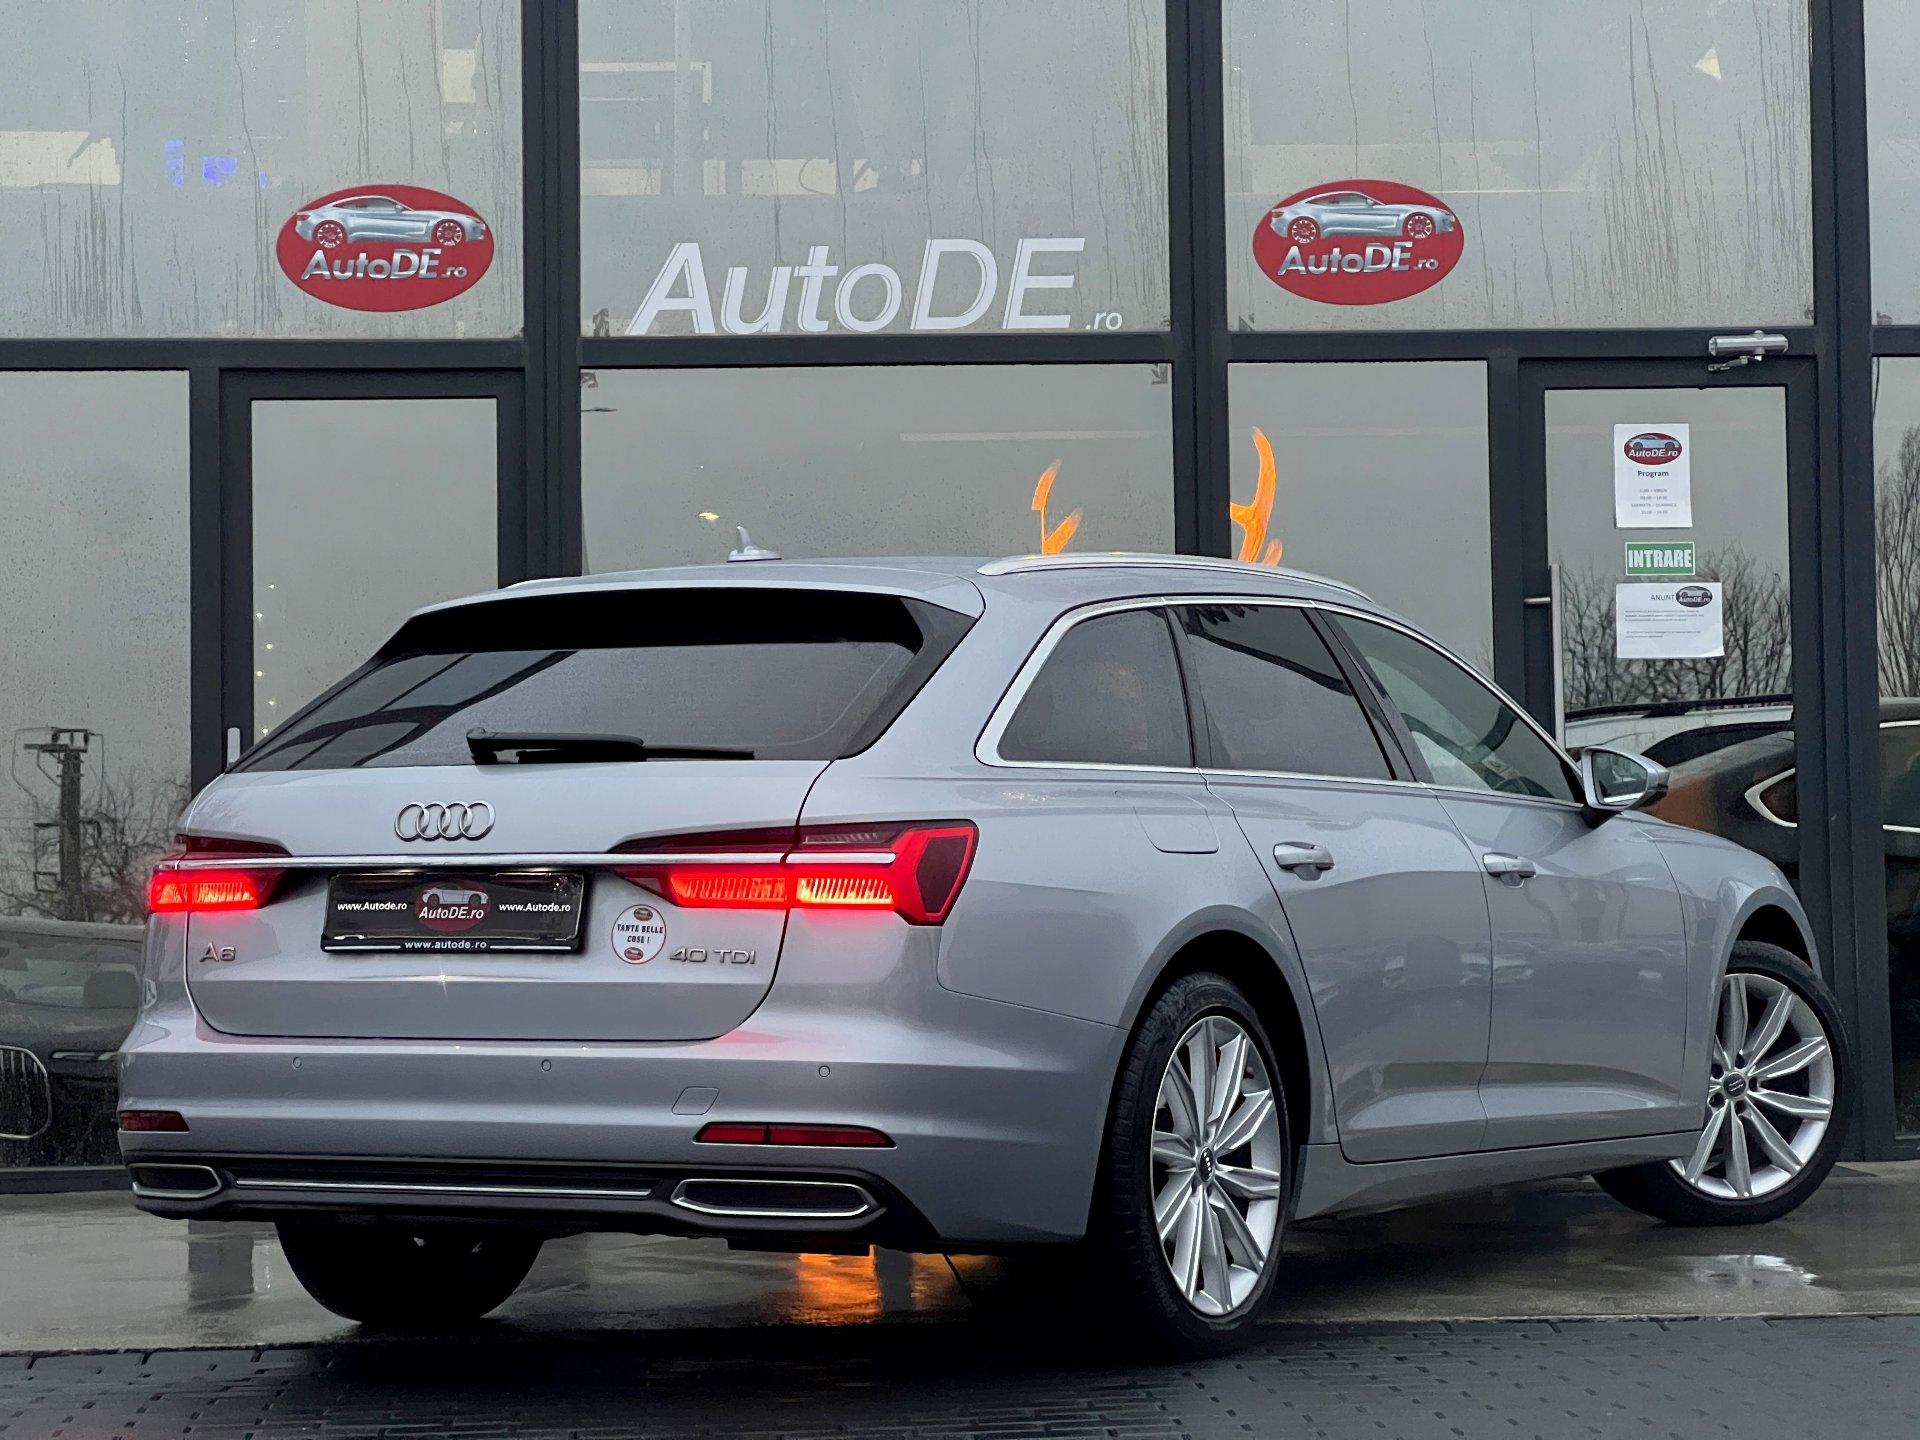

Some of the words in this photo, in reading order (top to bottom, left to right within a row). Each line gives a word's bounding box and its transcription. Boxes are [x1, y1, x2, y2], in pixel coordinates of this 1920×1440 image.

[1628, 449, 1678, 458] AutoDE.ro
[1637, 470, 1669, 478] Program
[1628, 550, 1693, 568] INTRARE
[337, 901, 407, 911] www.Autode.ro
[499, 902, 571, 912] www.Autode.ro
[418, 906, 485, 920] AutoDE.ro
[617, 924, 639, 933] TANTE
[642, 925, 663, 934] BELLE
[404, 939, 487, 949] www.autode.ro
[200, 941, 236, 962] A6
[670, 948, 708, 963] 40
[714, 949, 756, 964] TDI
